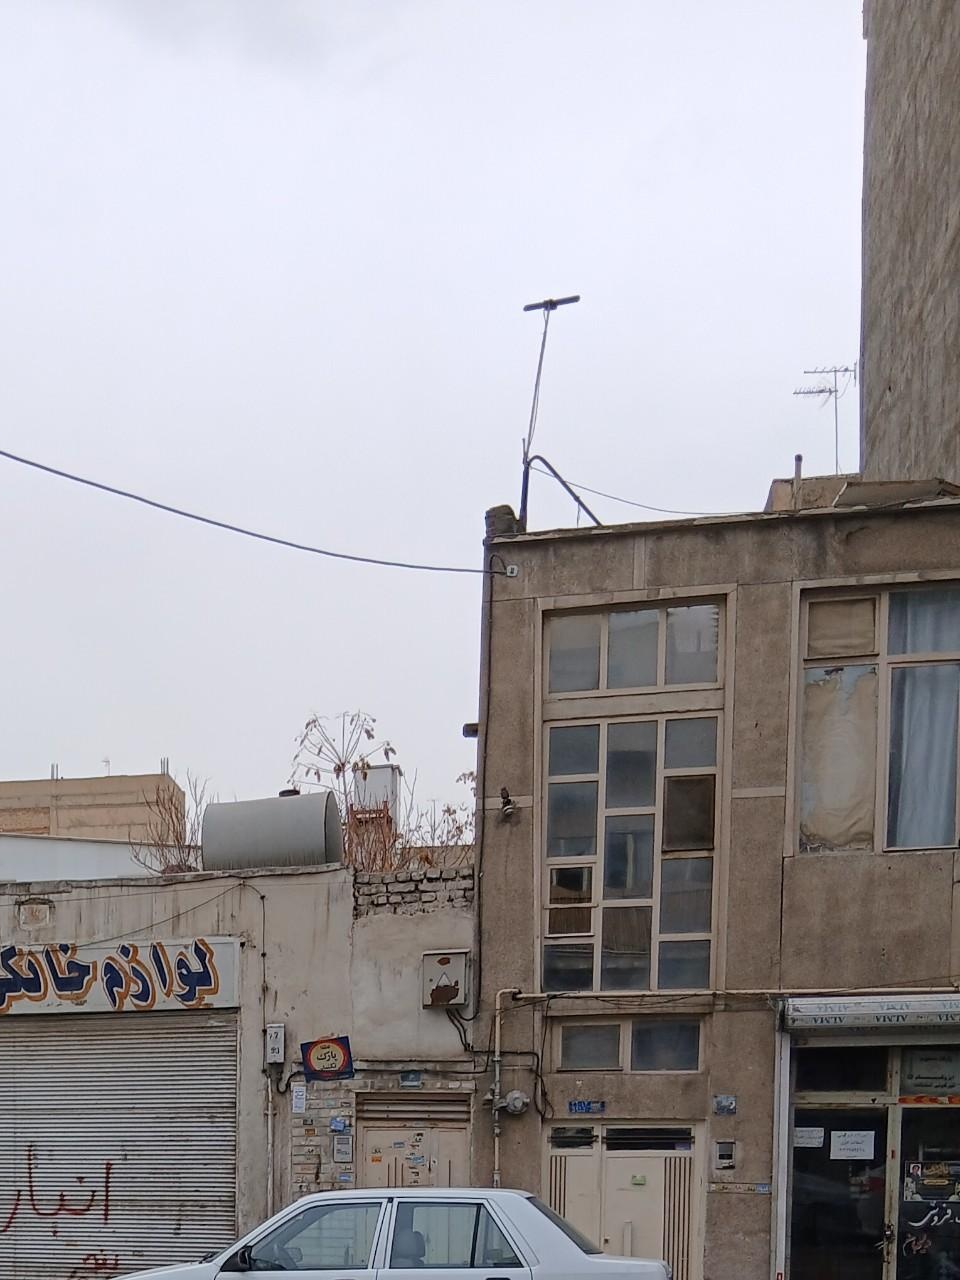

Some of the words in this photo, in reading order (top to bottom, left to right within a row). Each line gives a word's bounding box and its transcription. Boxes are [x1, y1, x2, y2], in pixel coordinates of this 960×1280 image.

[101, 937, 219, 1011] لوازم
[812, 1016, 844, 1024] ALMA
[875, 1014, 908, 1023] ALMA
[316, 1050, 338, 1062] پارک
[0, 1142, 113, 1237] انبار
